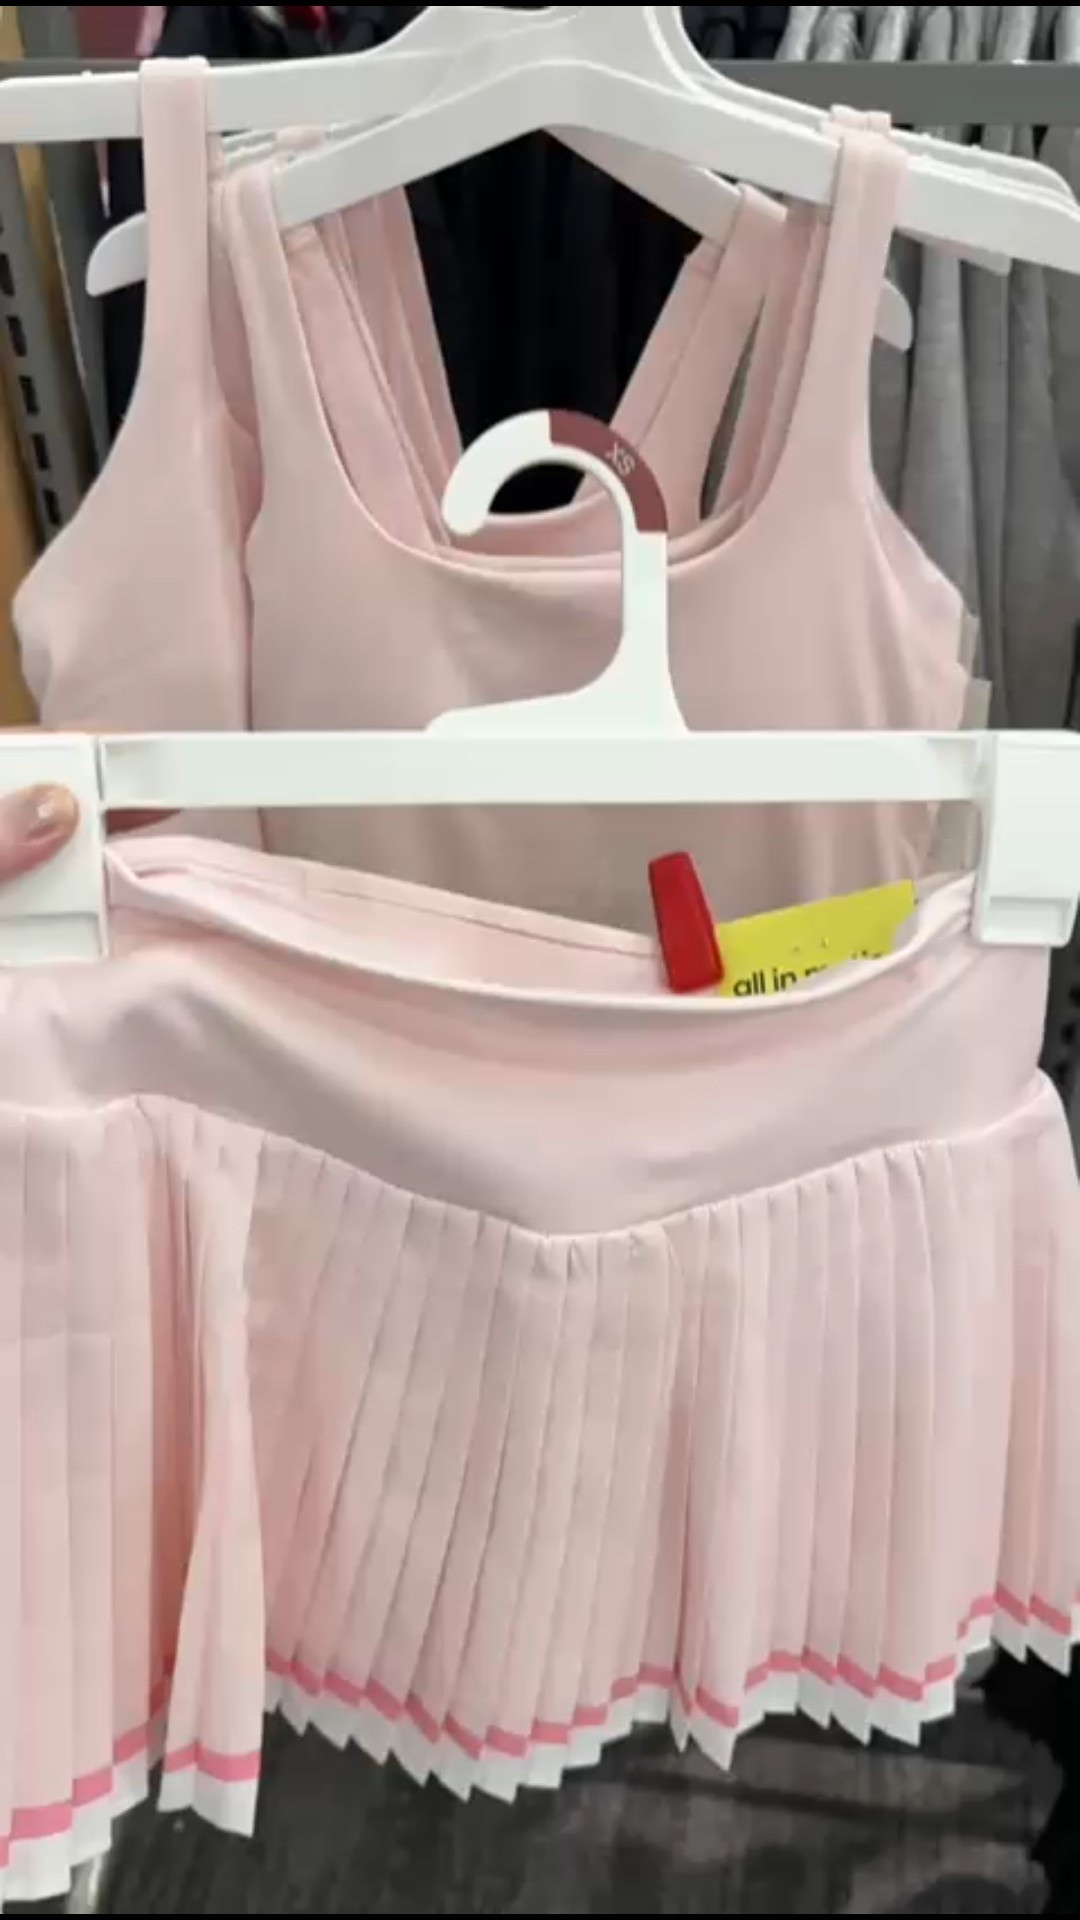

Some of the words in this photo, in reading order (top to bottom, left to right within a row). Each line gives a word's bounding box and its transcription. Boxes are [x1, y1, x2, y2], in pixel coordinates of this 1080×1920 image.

[604, 441, 636, 476] XS
[733, 970, 767, 997] all
[772, 966, 798, 992] in
